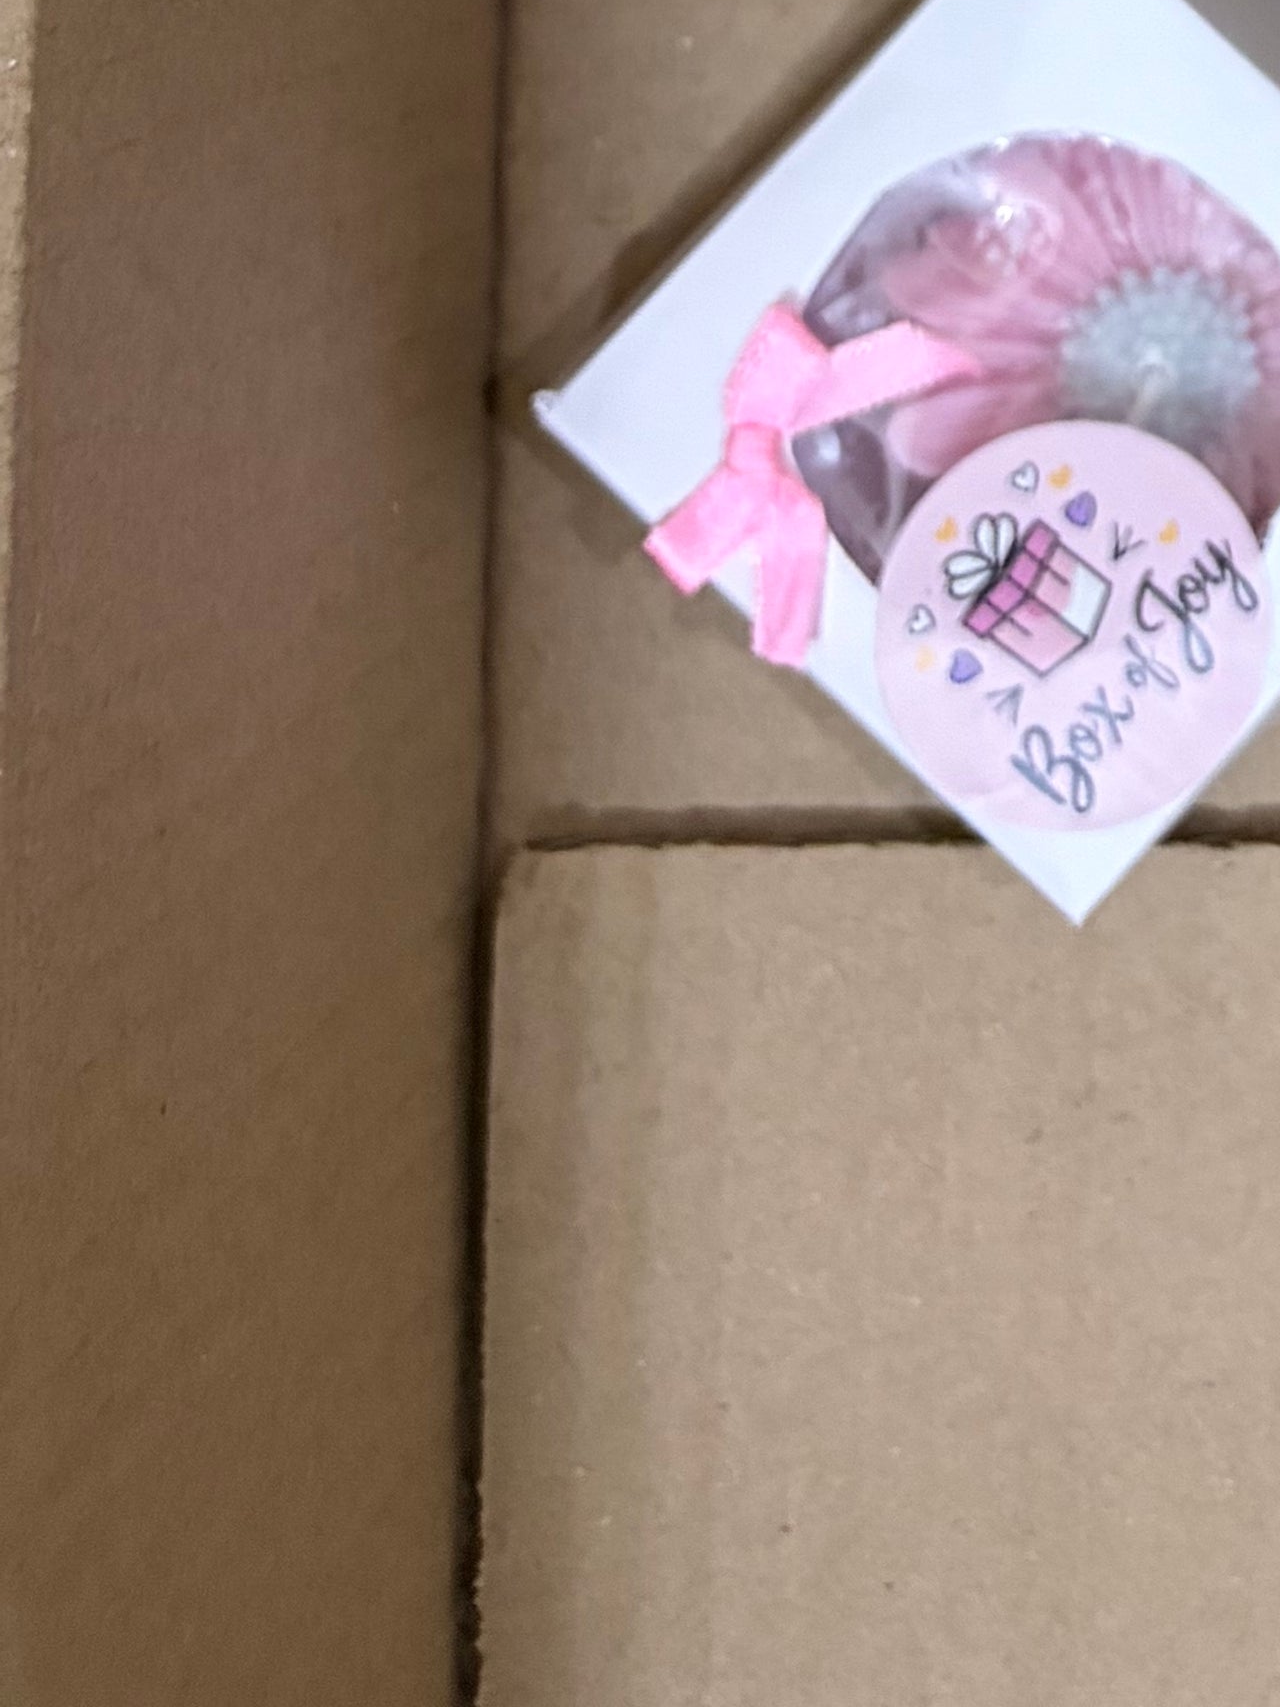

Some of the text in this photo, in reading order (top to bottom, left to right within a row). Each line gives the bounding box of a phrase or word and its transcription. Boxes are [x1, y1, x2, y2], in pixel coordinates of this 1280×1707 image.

[1010, 538, 1259, 814] Box of Joy
